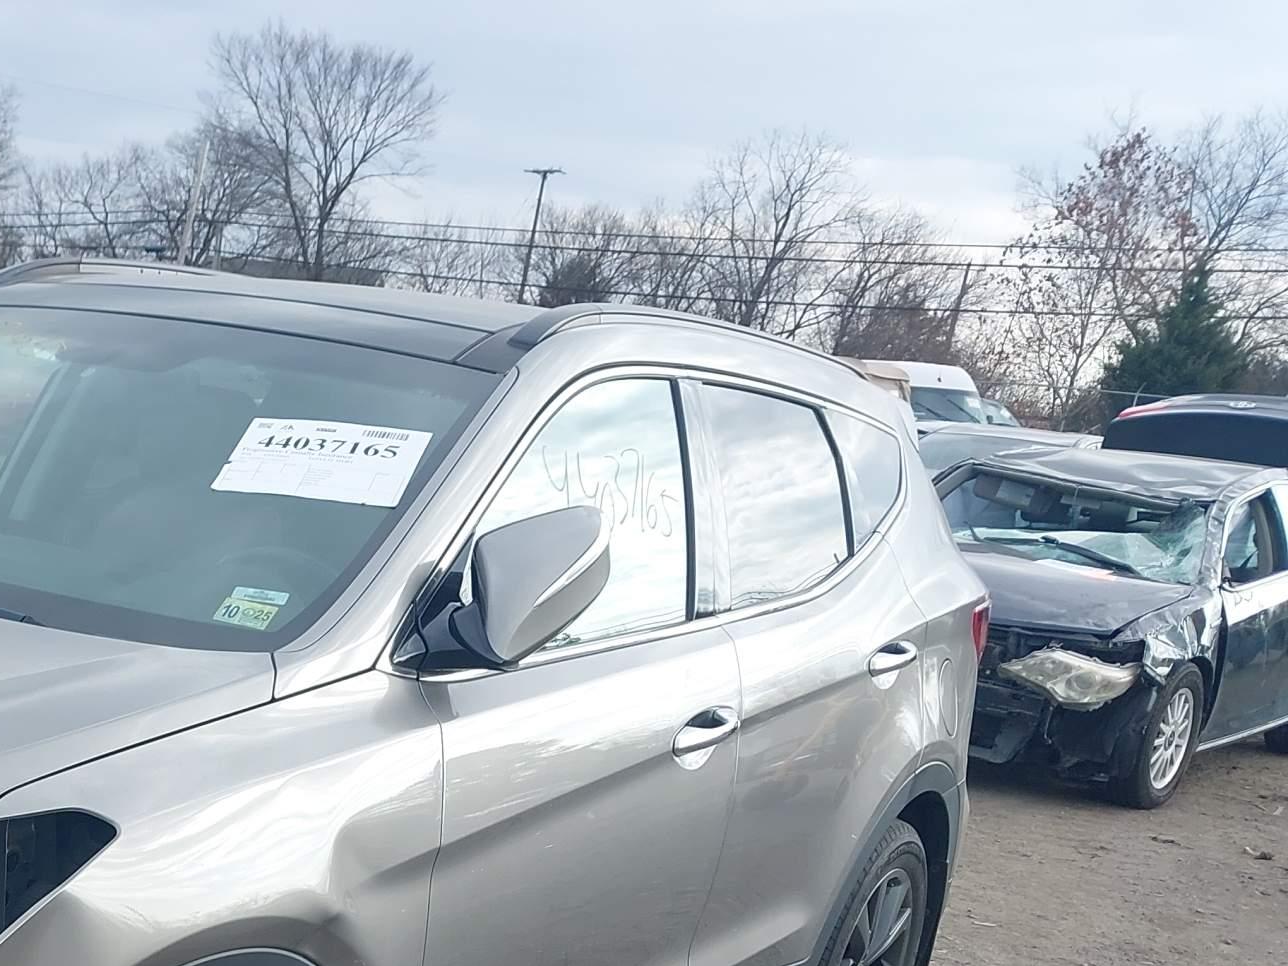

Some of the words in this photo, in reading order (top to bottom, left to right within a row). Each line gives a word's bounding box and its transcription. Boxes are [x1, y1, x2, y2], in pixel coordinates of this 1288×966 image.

[257, 434, 401, 459] 44037165
[222, 603, 241, 619] 10
[254, 609, 273, 622] 25
